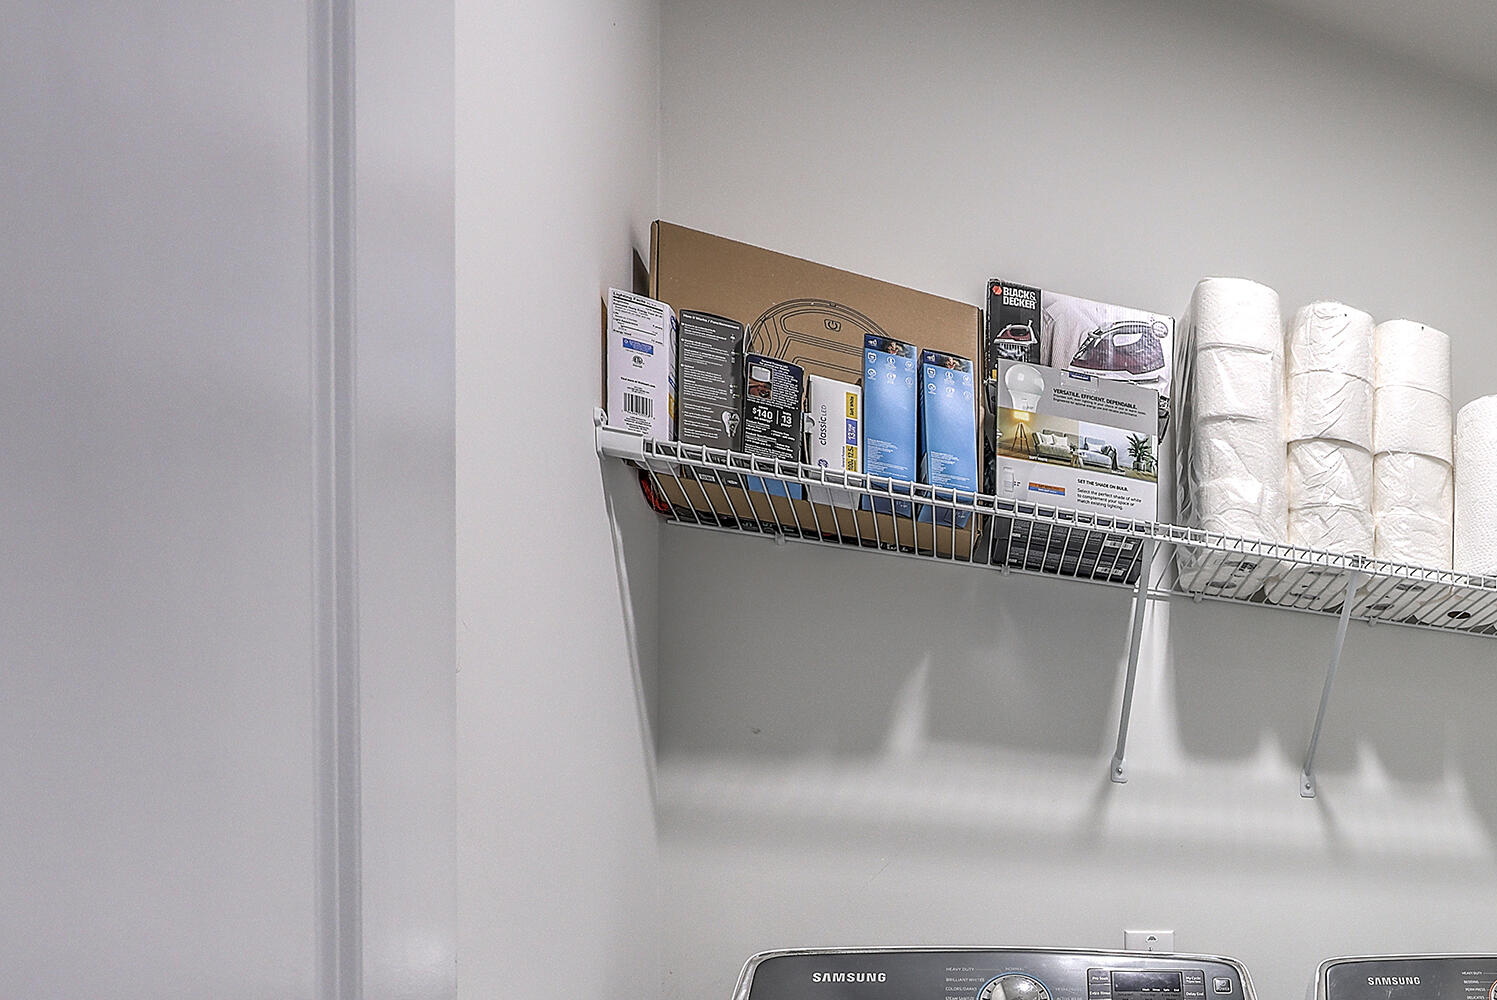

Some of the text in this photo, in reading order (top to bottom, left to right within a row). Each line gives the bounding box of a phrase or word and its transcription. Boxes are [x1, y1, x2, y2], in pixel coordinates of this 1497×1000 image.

[1003, 286, 1036, 302] BLACK&
[1002, 296, 1036, 310] DECKER
[752, 407, 773, 420] $140
[781, 415, 792, 424] 13
[812, 972, 887, 983] SAMSUNG
[1367, 976, 1420, 986] SAMSUNG
